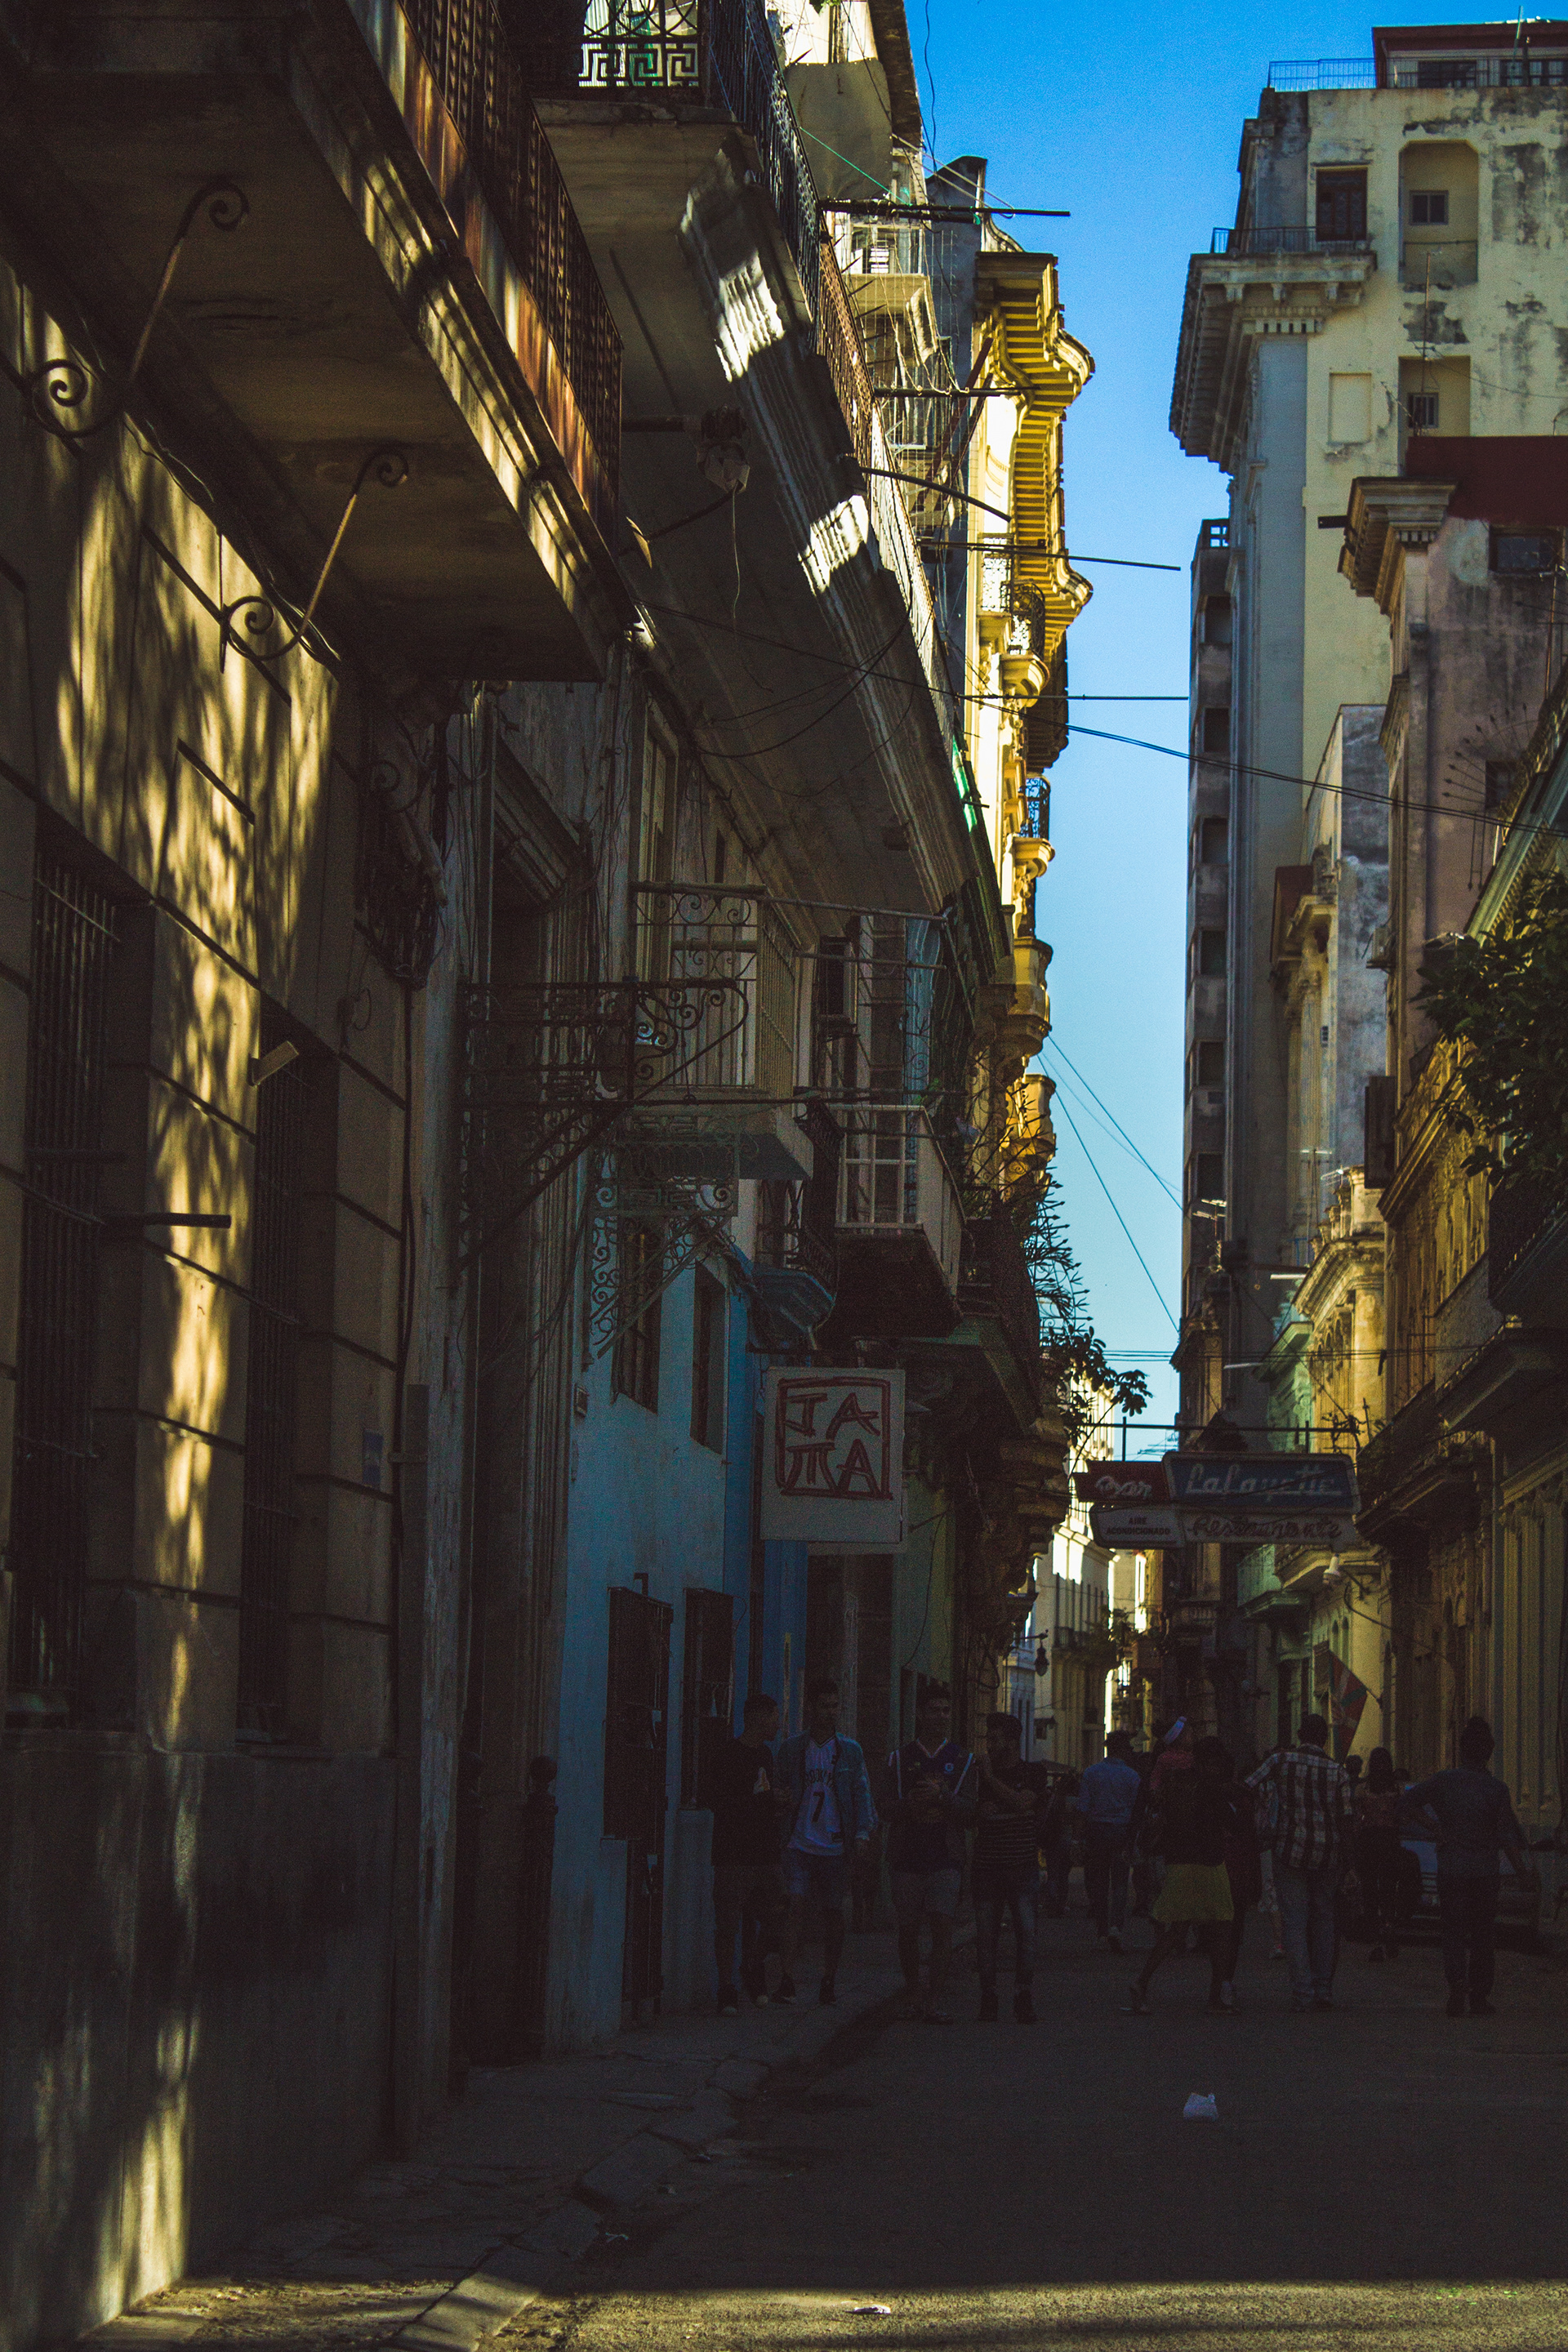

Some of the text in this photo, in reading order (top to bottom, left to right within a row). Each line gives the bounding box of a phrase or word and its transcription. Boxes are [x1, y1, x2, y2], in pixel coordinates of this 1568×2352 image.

[1128, 1517, 1147, 1526] AIRE
[1188, 1516, 1343, 1539] Restaurante
[1106, 1527, 1171, 1535] ACONDICIONADO
[813, 1792, 825, 1822] 7
